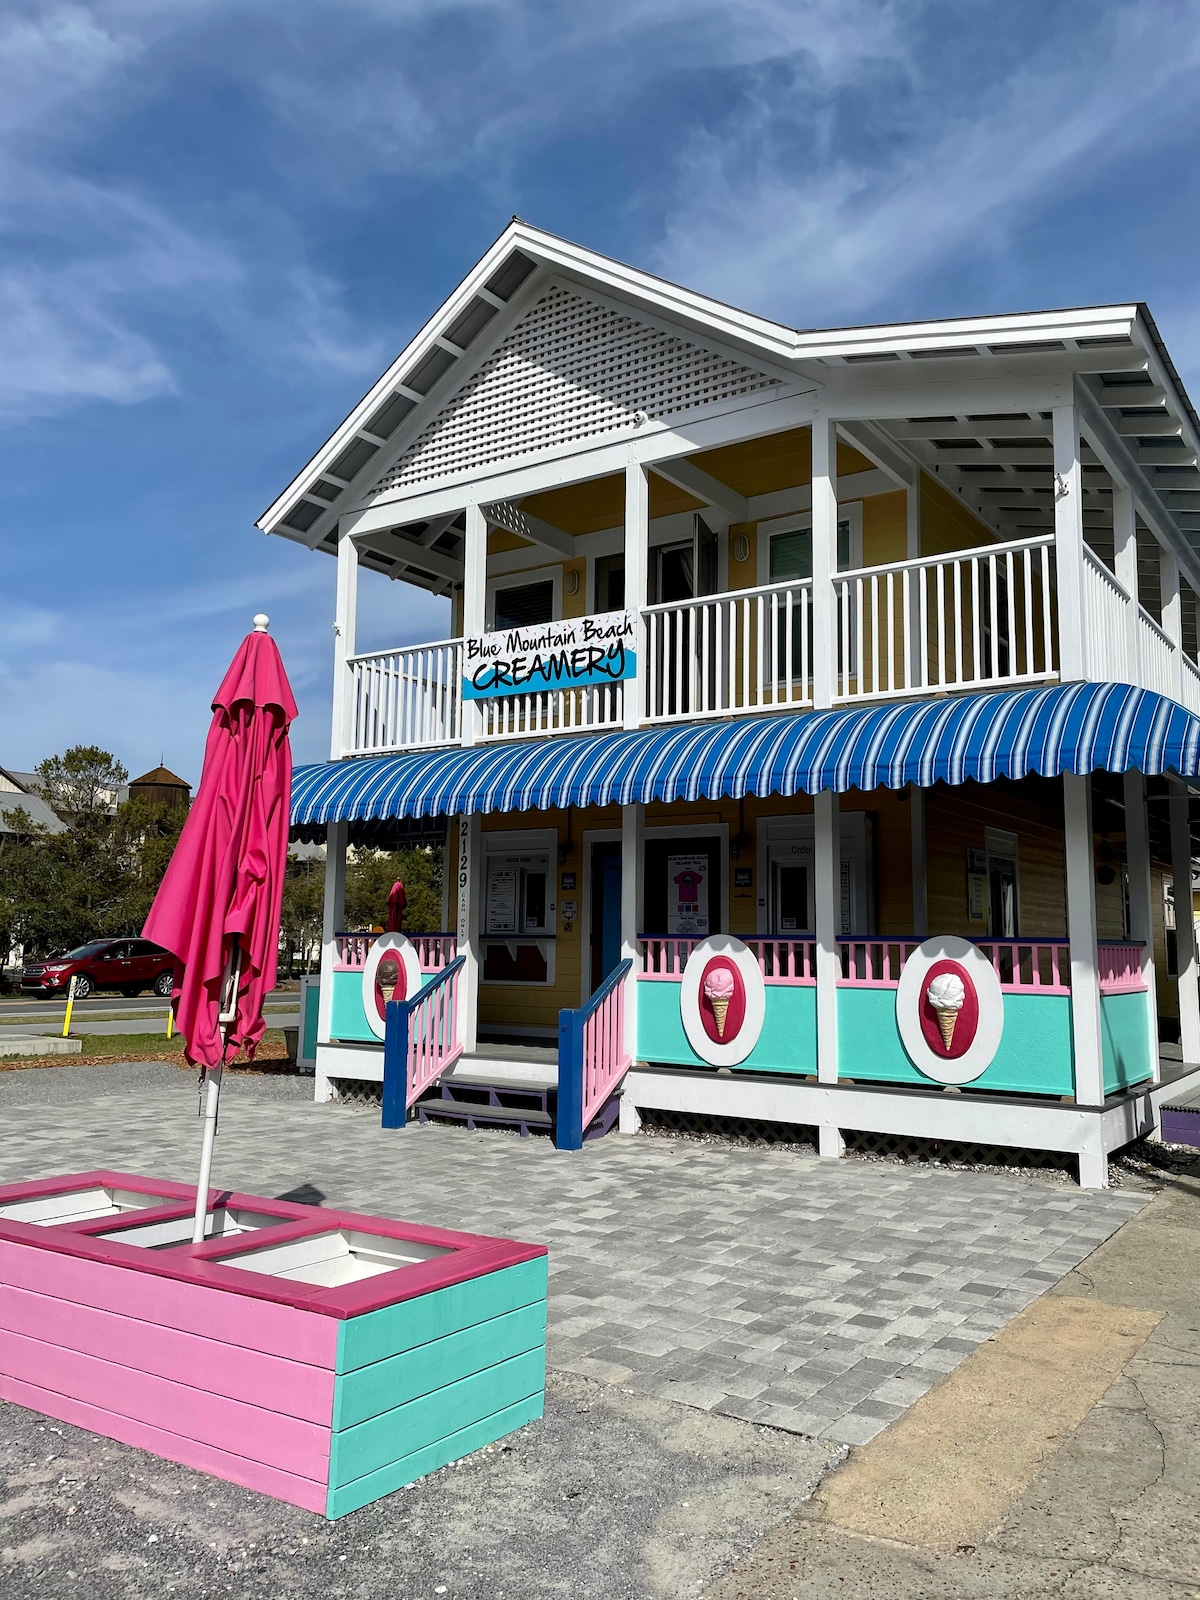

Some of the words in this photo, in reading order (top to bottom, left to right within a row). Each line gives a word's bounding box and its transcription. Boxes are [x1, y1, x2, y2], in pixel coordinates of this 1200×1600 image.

[467, 638, 501, 659] Blue
[506, 627, 576, 653] Mountain
[582, 614, 633, 642] Beach
[472, 638, 625, 690] CREAMERY
[459, 821, 469, 888] 2129
[791, 845, 812, 855] Order
